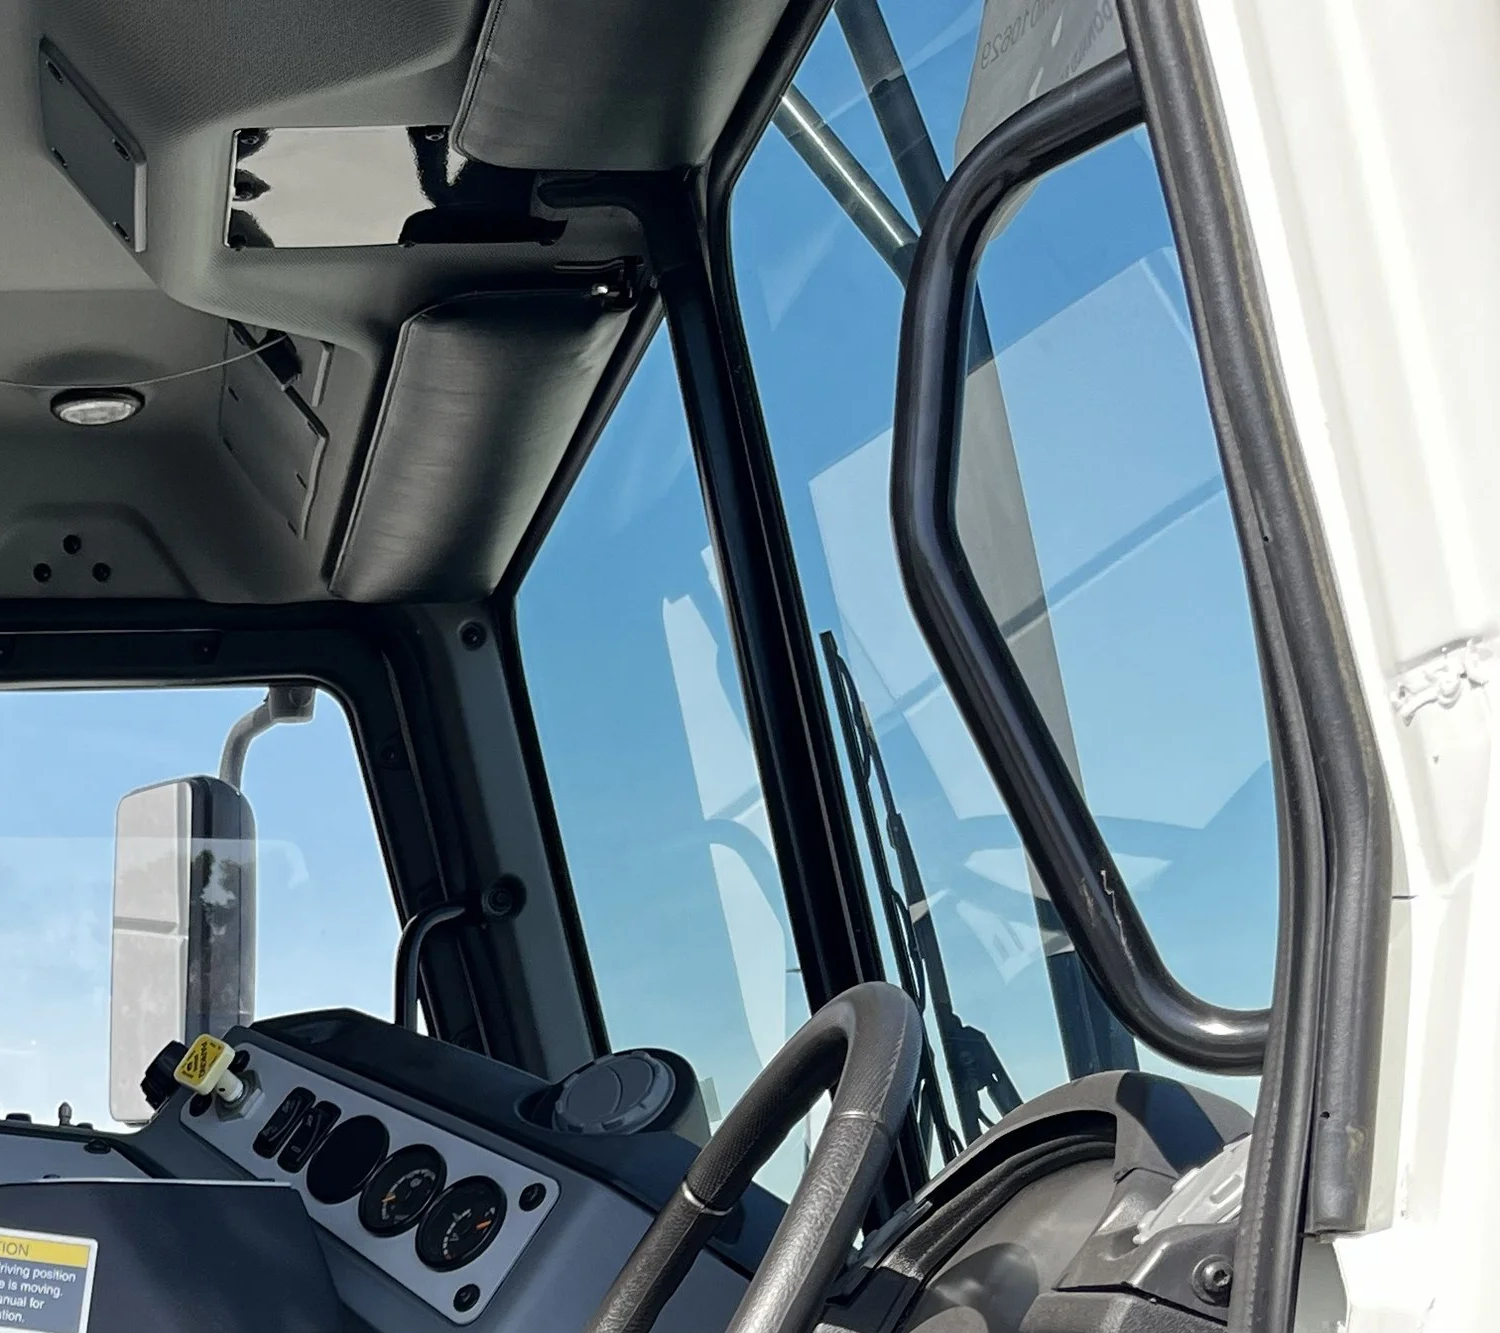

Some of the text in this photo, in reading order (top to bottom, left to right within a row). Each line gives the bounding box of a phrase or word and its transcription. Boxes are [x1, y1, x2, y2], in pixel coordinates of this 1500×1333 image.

[33, 1268, 76, 1282] position
[8, 1279, 18, 1290] is
[21, 1283, 63, 1299] moving.
[29, 1297, 44, 1309] for
